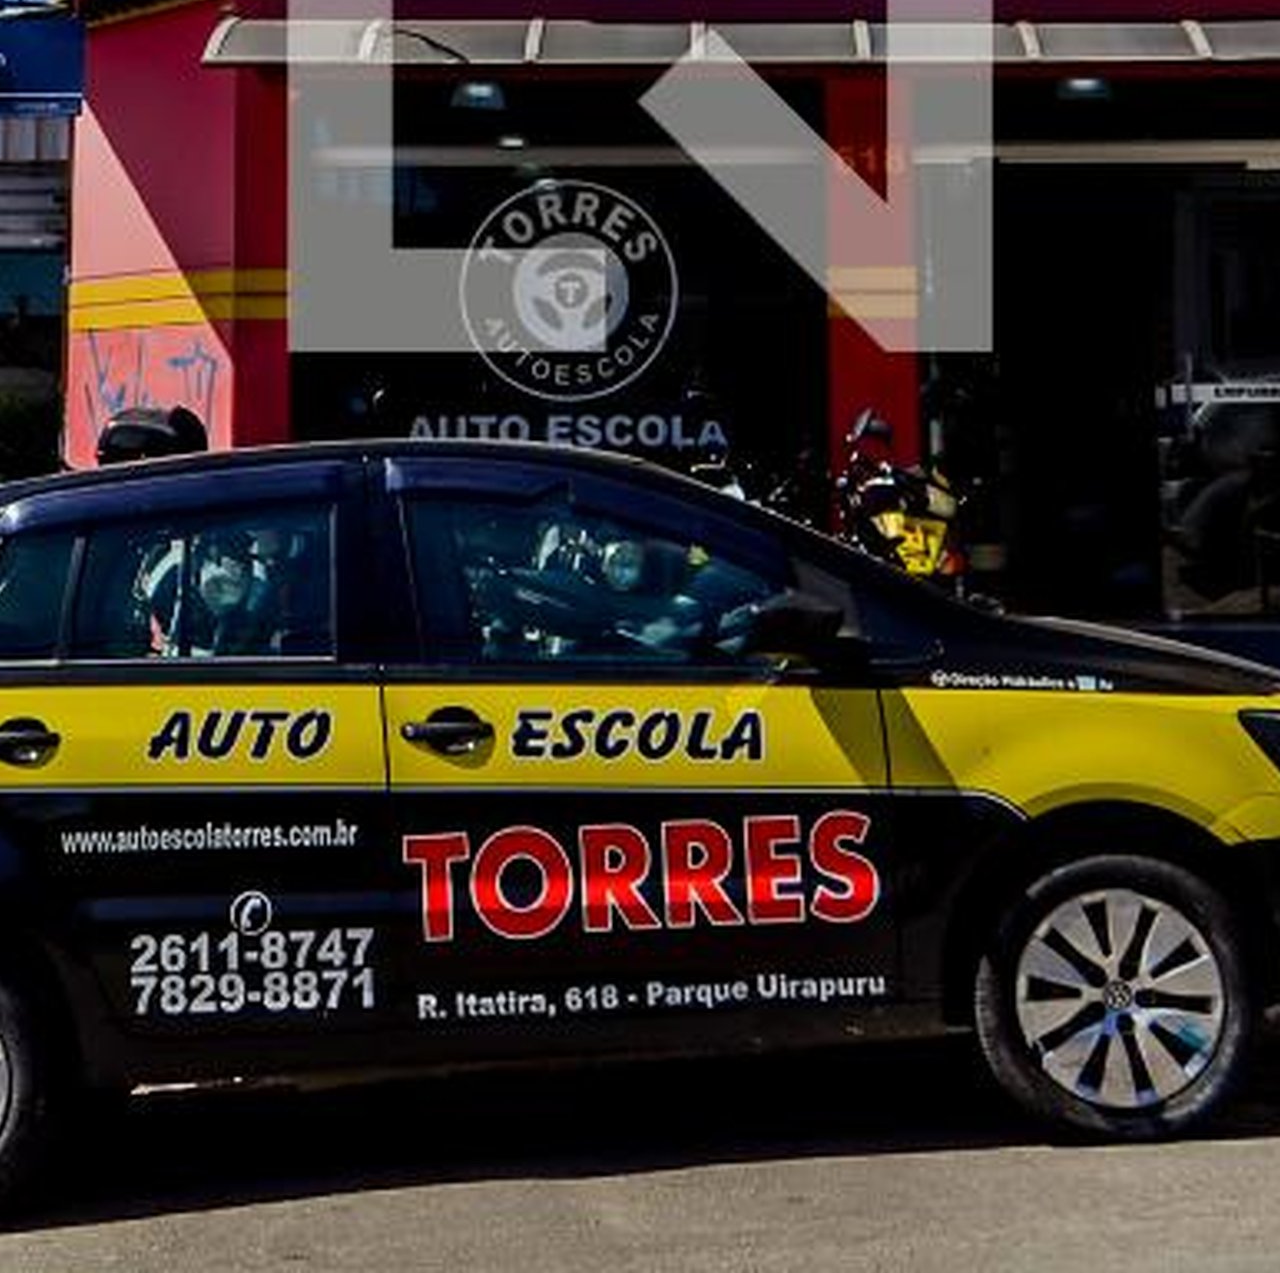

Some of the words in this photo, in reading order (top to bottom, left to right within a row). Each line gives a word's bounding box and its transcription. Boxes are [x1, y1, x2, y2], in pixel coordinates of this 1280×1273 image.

[478, 191, 658, 264] TORRES
[484, 313, 660, 386] AUTOESCOLA
[409, 416, 530, 442] AUTO
[548, 415, 728, 446] ESCOLA
[147, 710, 332, 761] AUTO
[512, 711, 763, 761] ESCOLA
[61, 818, 359, 854] www.autoescolatorres.com.br
[402, 809, 880, 943] TORRES
[130, 928, 375, 973] 2611-8747
[130, 968, 375, 1015] 7829-8871
[417, 994, 447, 1019] R.
[456, 991, 557, 1017] Itatira,
[564, 984, 620, 1010] 618
[646, 978, 749, 1008] Parque
[756, 973, 887, 1001] Uirapuru
